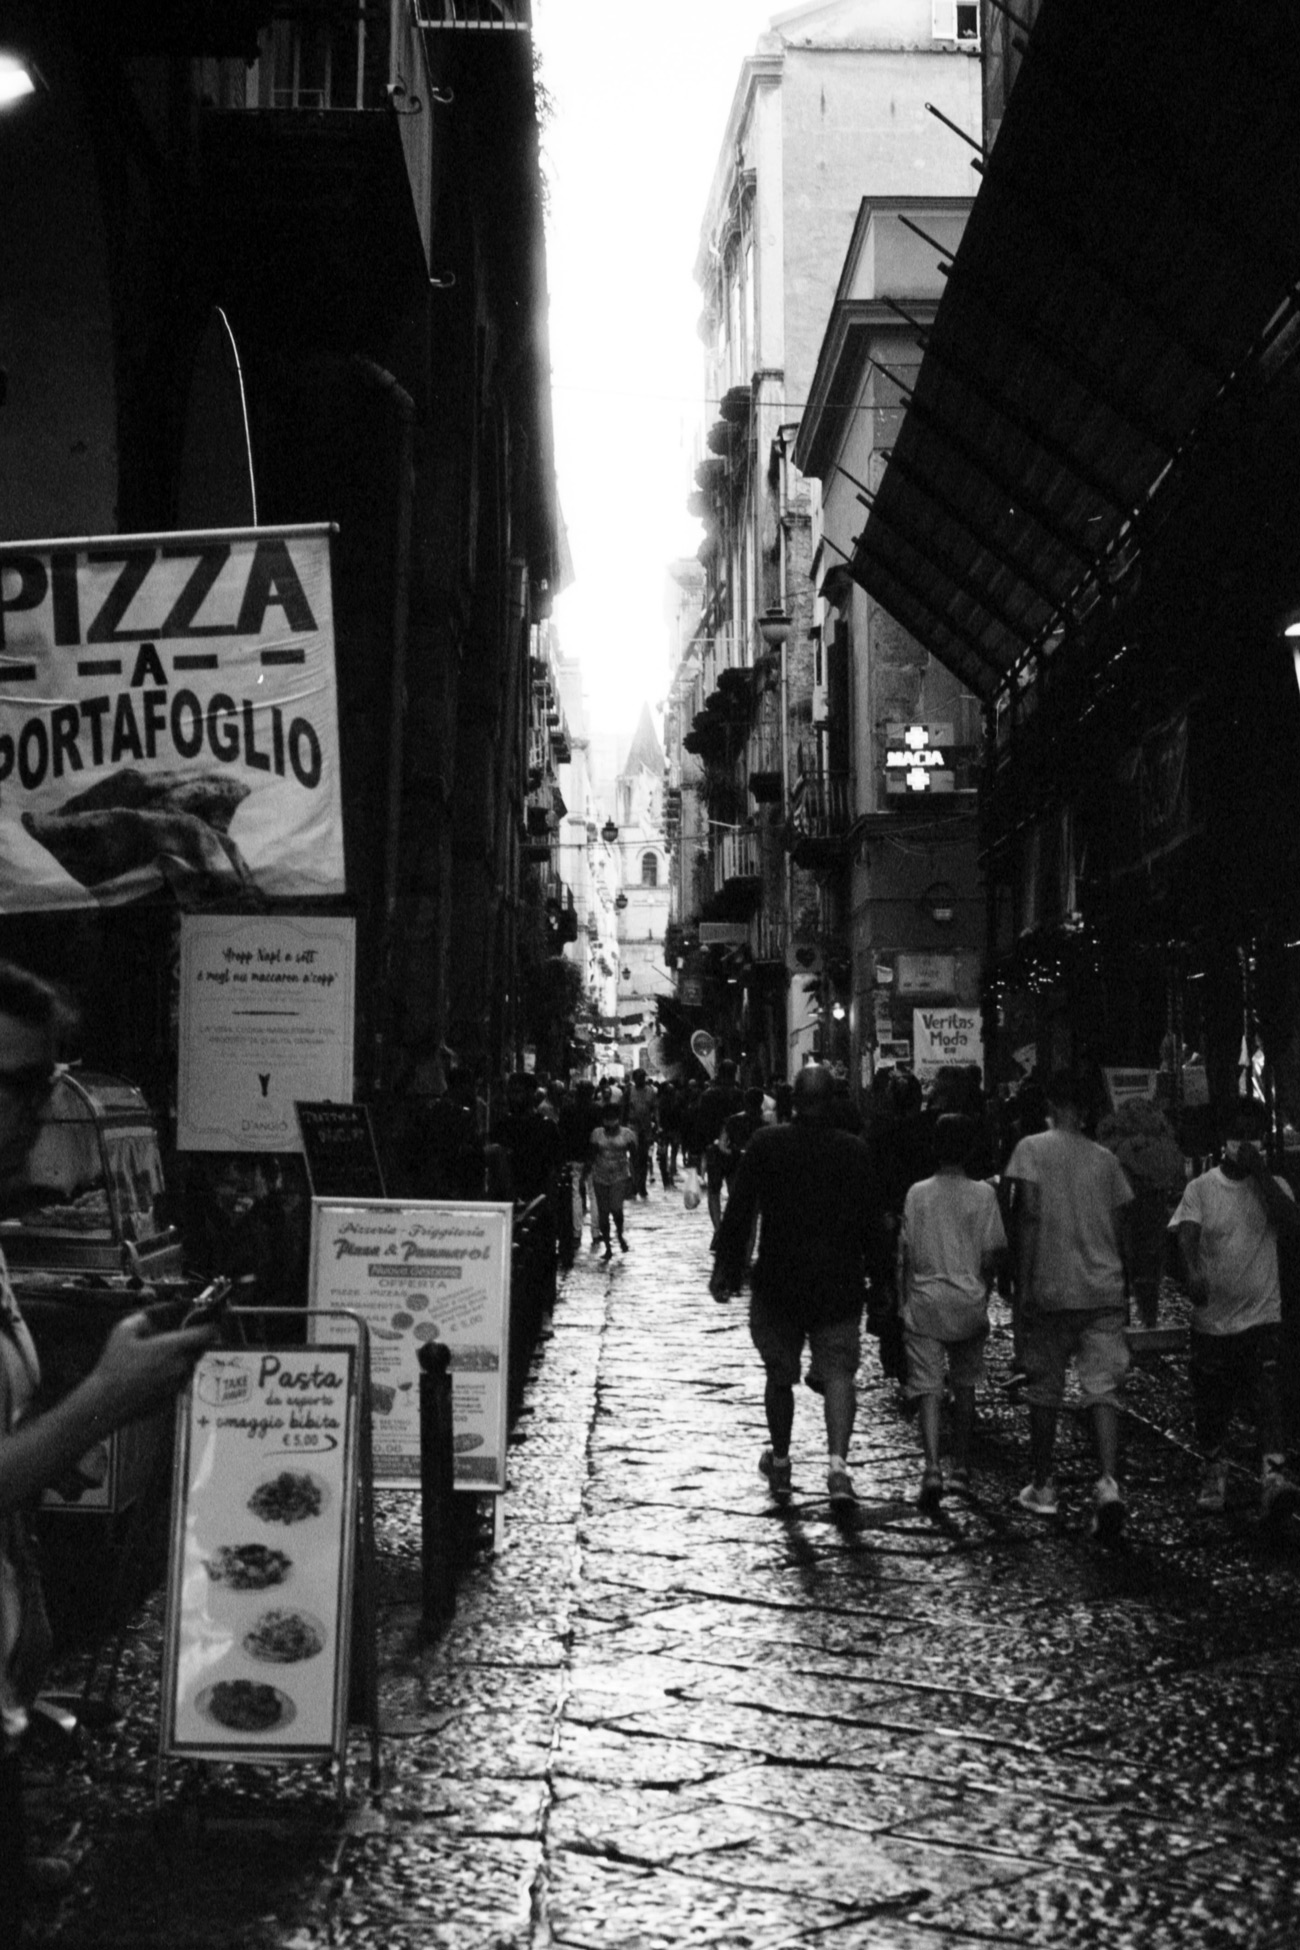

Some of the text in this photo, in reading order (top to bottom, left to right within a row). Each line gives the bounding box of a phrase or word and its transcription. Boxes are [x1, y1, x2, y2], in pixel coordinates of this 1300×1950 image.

[0, 541, 318, 650] PIZZA
[131, 643, 168, 687] A
[922, 1013, 974, 1029] Veritas
[930, 1031, 967, 1046] Moda
[338, 1222, 396, 1236] Pizzeria
[384, 1243, 398, 1256] &
[378, 1278, 447, 1289] OFFERTA
[259, 1354, 343, 1391] Pasta
[290, 1409, 340, 1430] bibita
